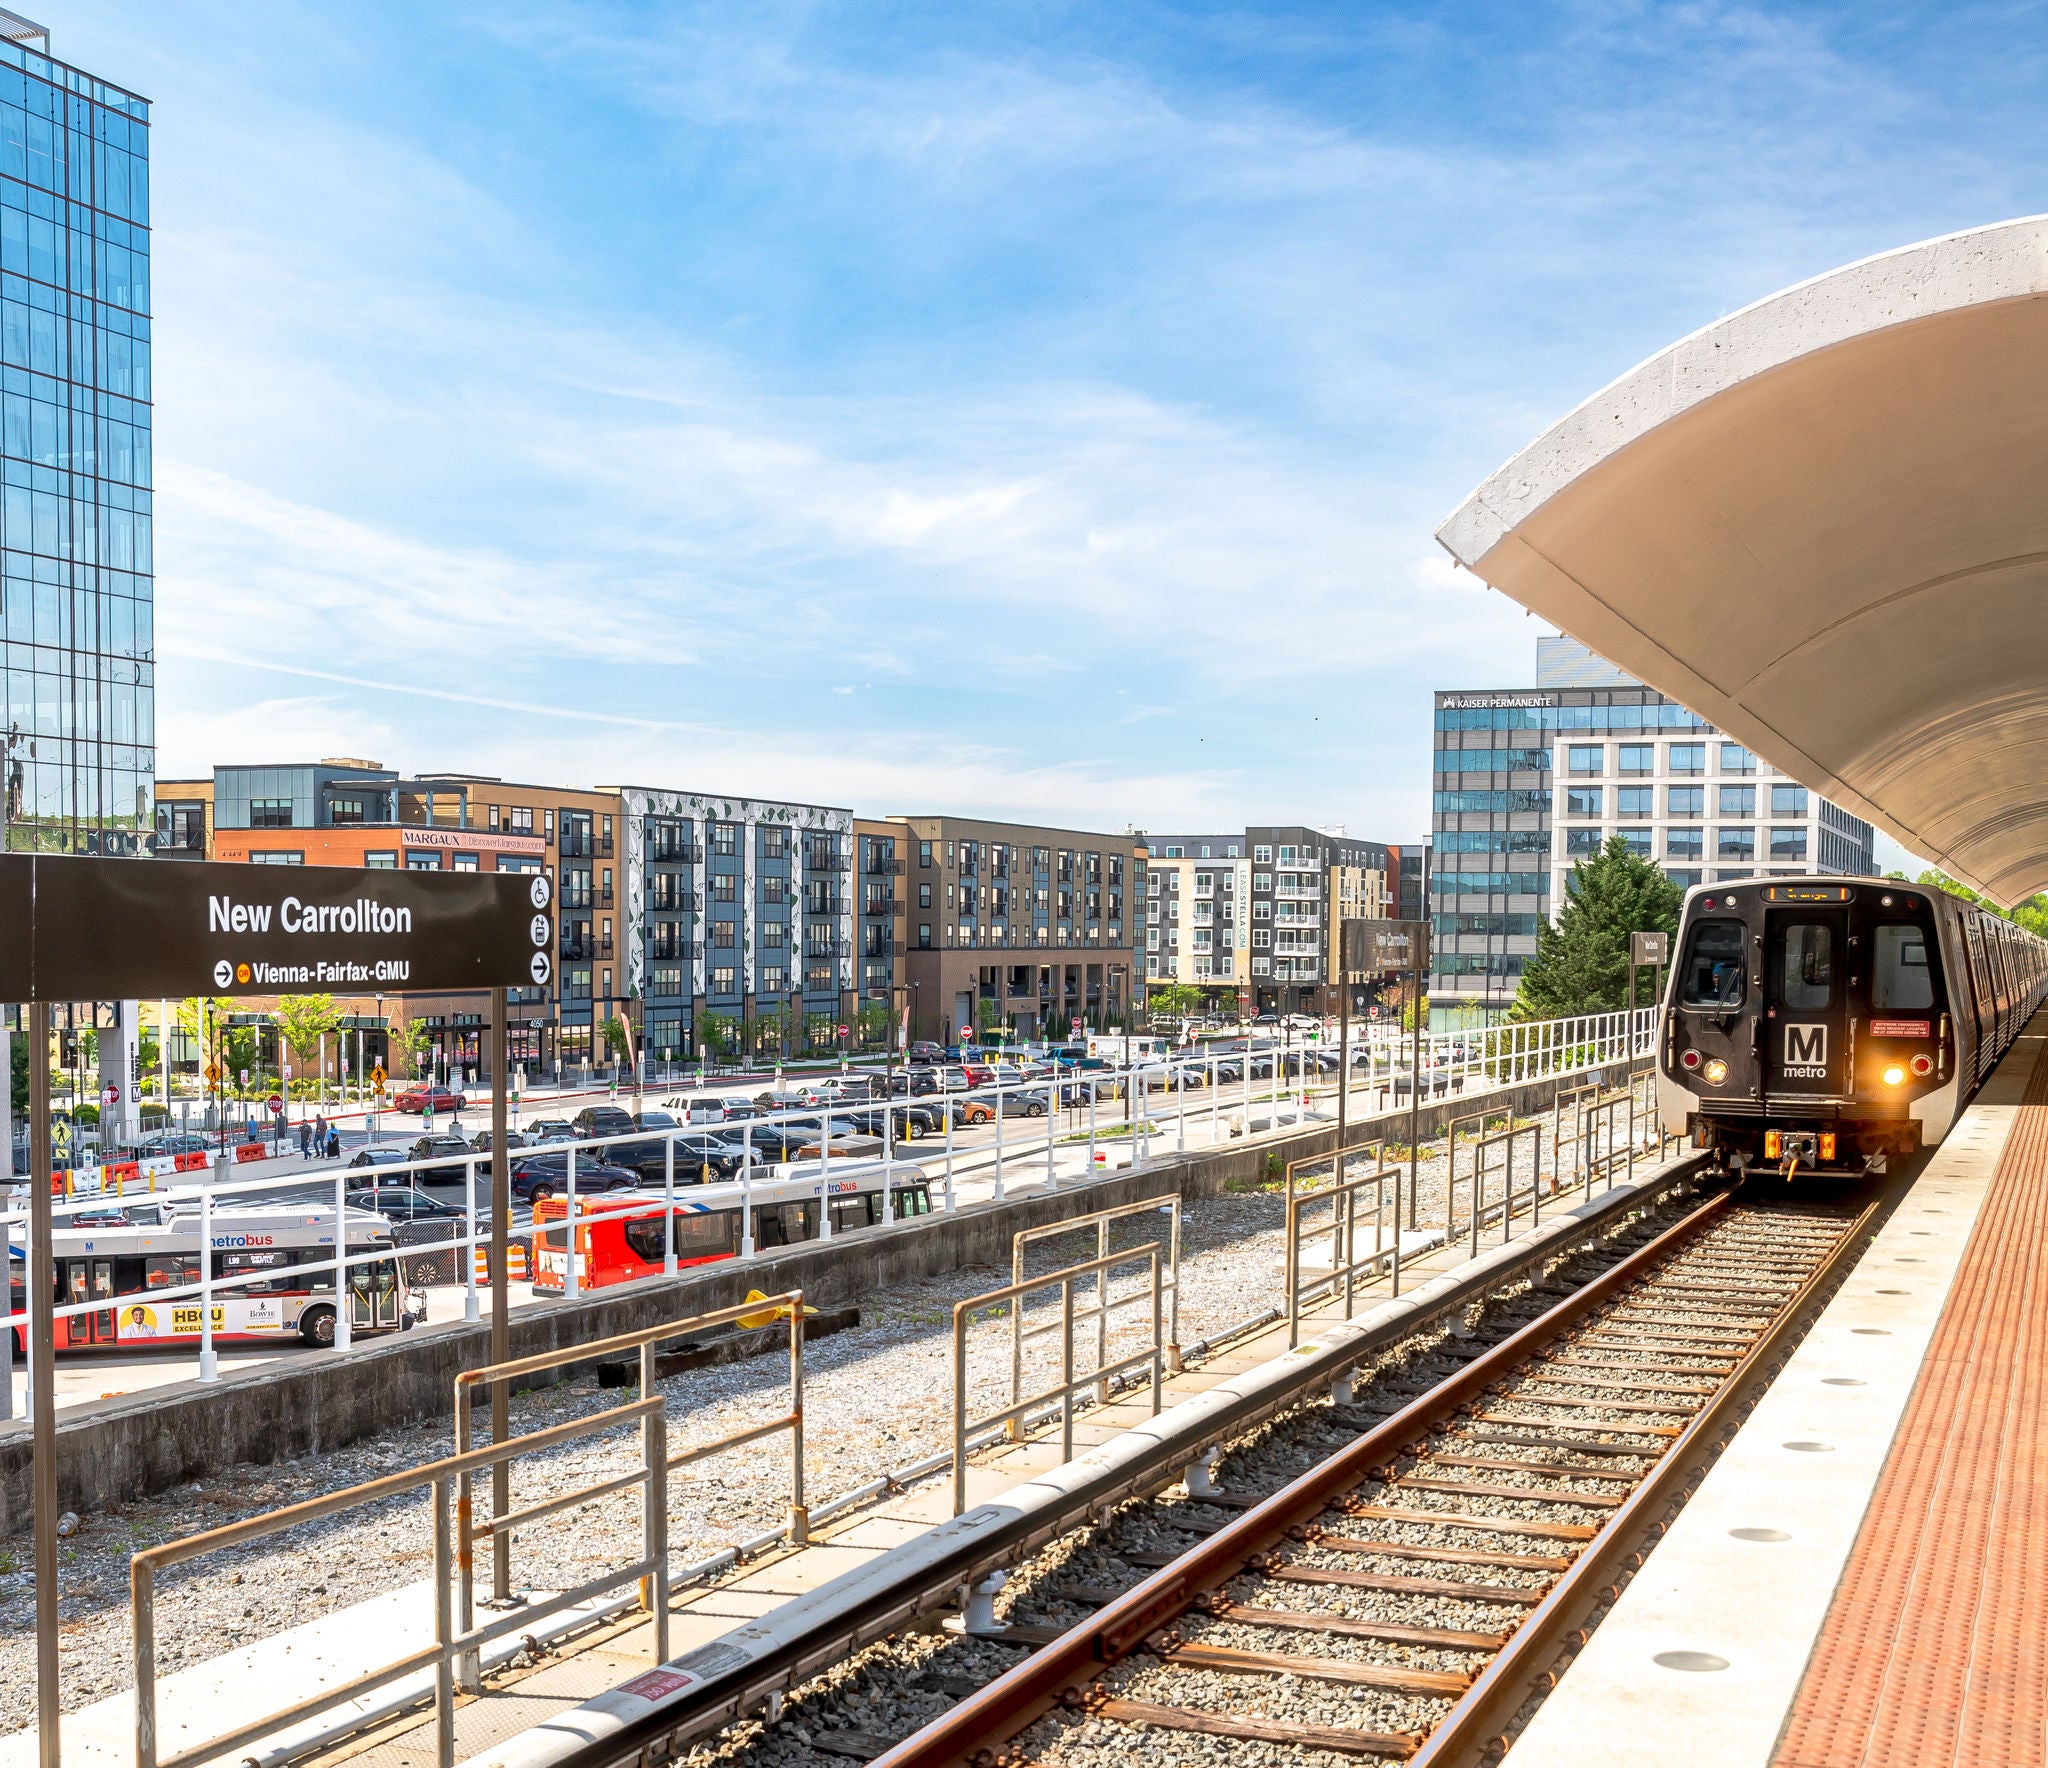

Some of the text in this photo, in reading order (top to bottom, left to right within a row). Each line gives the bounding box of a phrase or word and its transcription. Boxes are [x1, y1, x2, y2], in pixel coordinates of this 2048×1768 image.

[1458, 698, 1551, 708] KAISER PERMANENTE
[404, 832, 460, 846] MARGAUX
[209, 896, 411, 933] New Carrollton
[238, 960, 410, 984] OR Vienna-Fairfax-GMU
[529, 1019, 544, 1028] 4050
[1787, 1026, 1824, 1062] M
[1783, 1066, 1826, 1078] metro
[269, 1100, 282, 1108] STOP
[814, 1181, 858, 1195] mtrobus
[86, 1242, 94, 1250] M
[174, 1309, 222, 1322] HBU
